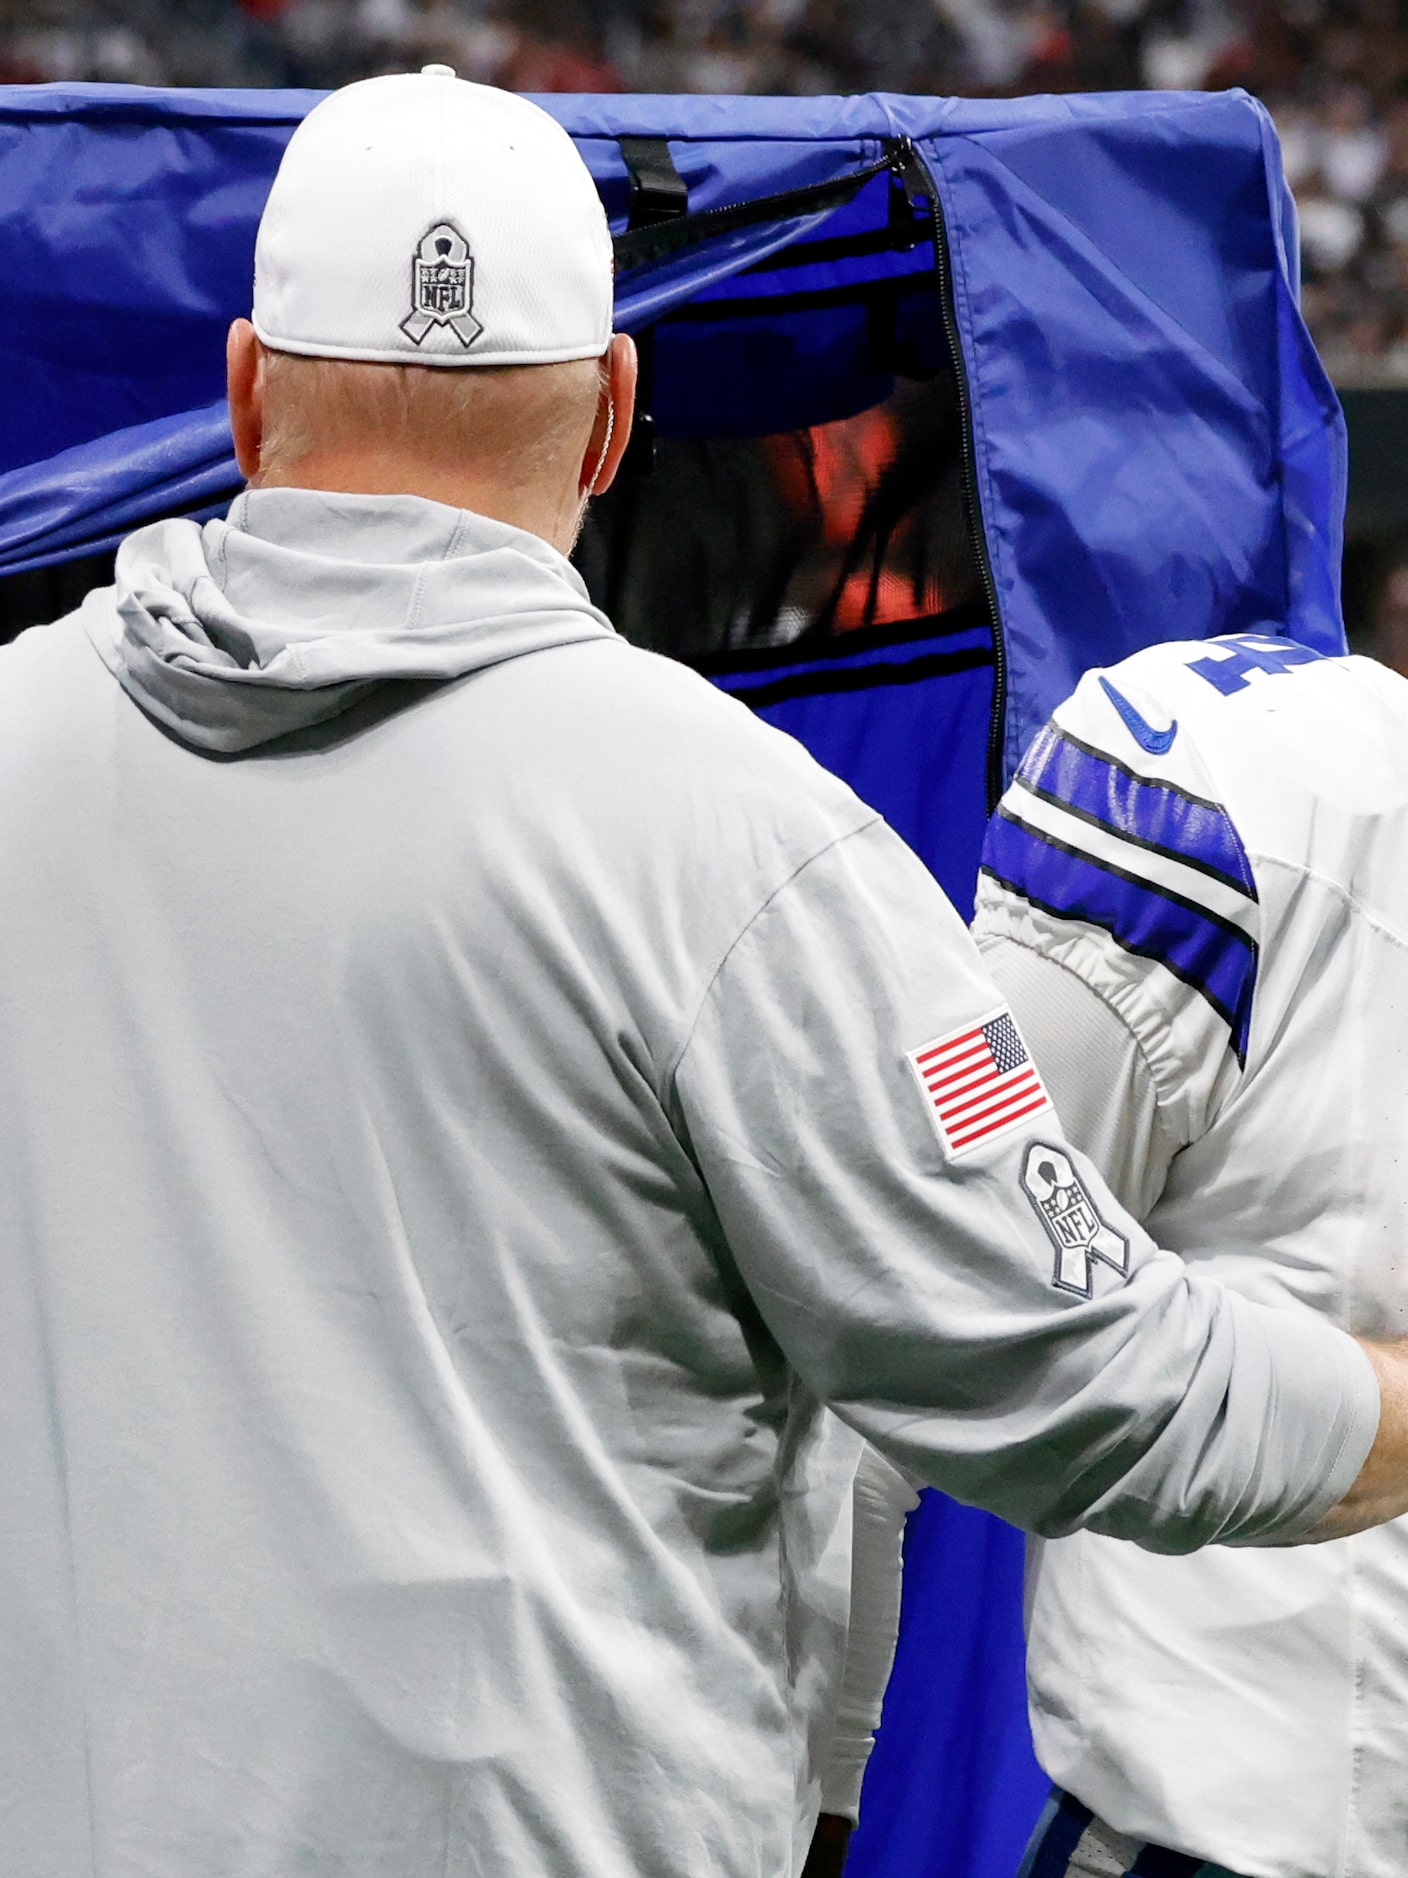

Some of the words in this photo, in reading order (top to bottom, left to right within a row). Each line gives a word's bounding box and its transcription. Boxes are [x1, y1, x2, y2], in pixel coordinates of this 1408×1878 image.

[423, 286, 461, 312] NFL
[1184, 636, 1328, 696] 4
[1055, 1207, 1097, 1243] NFL
